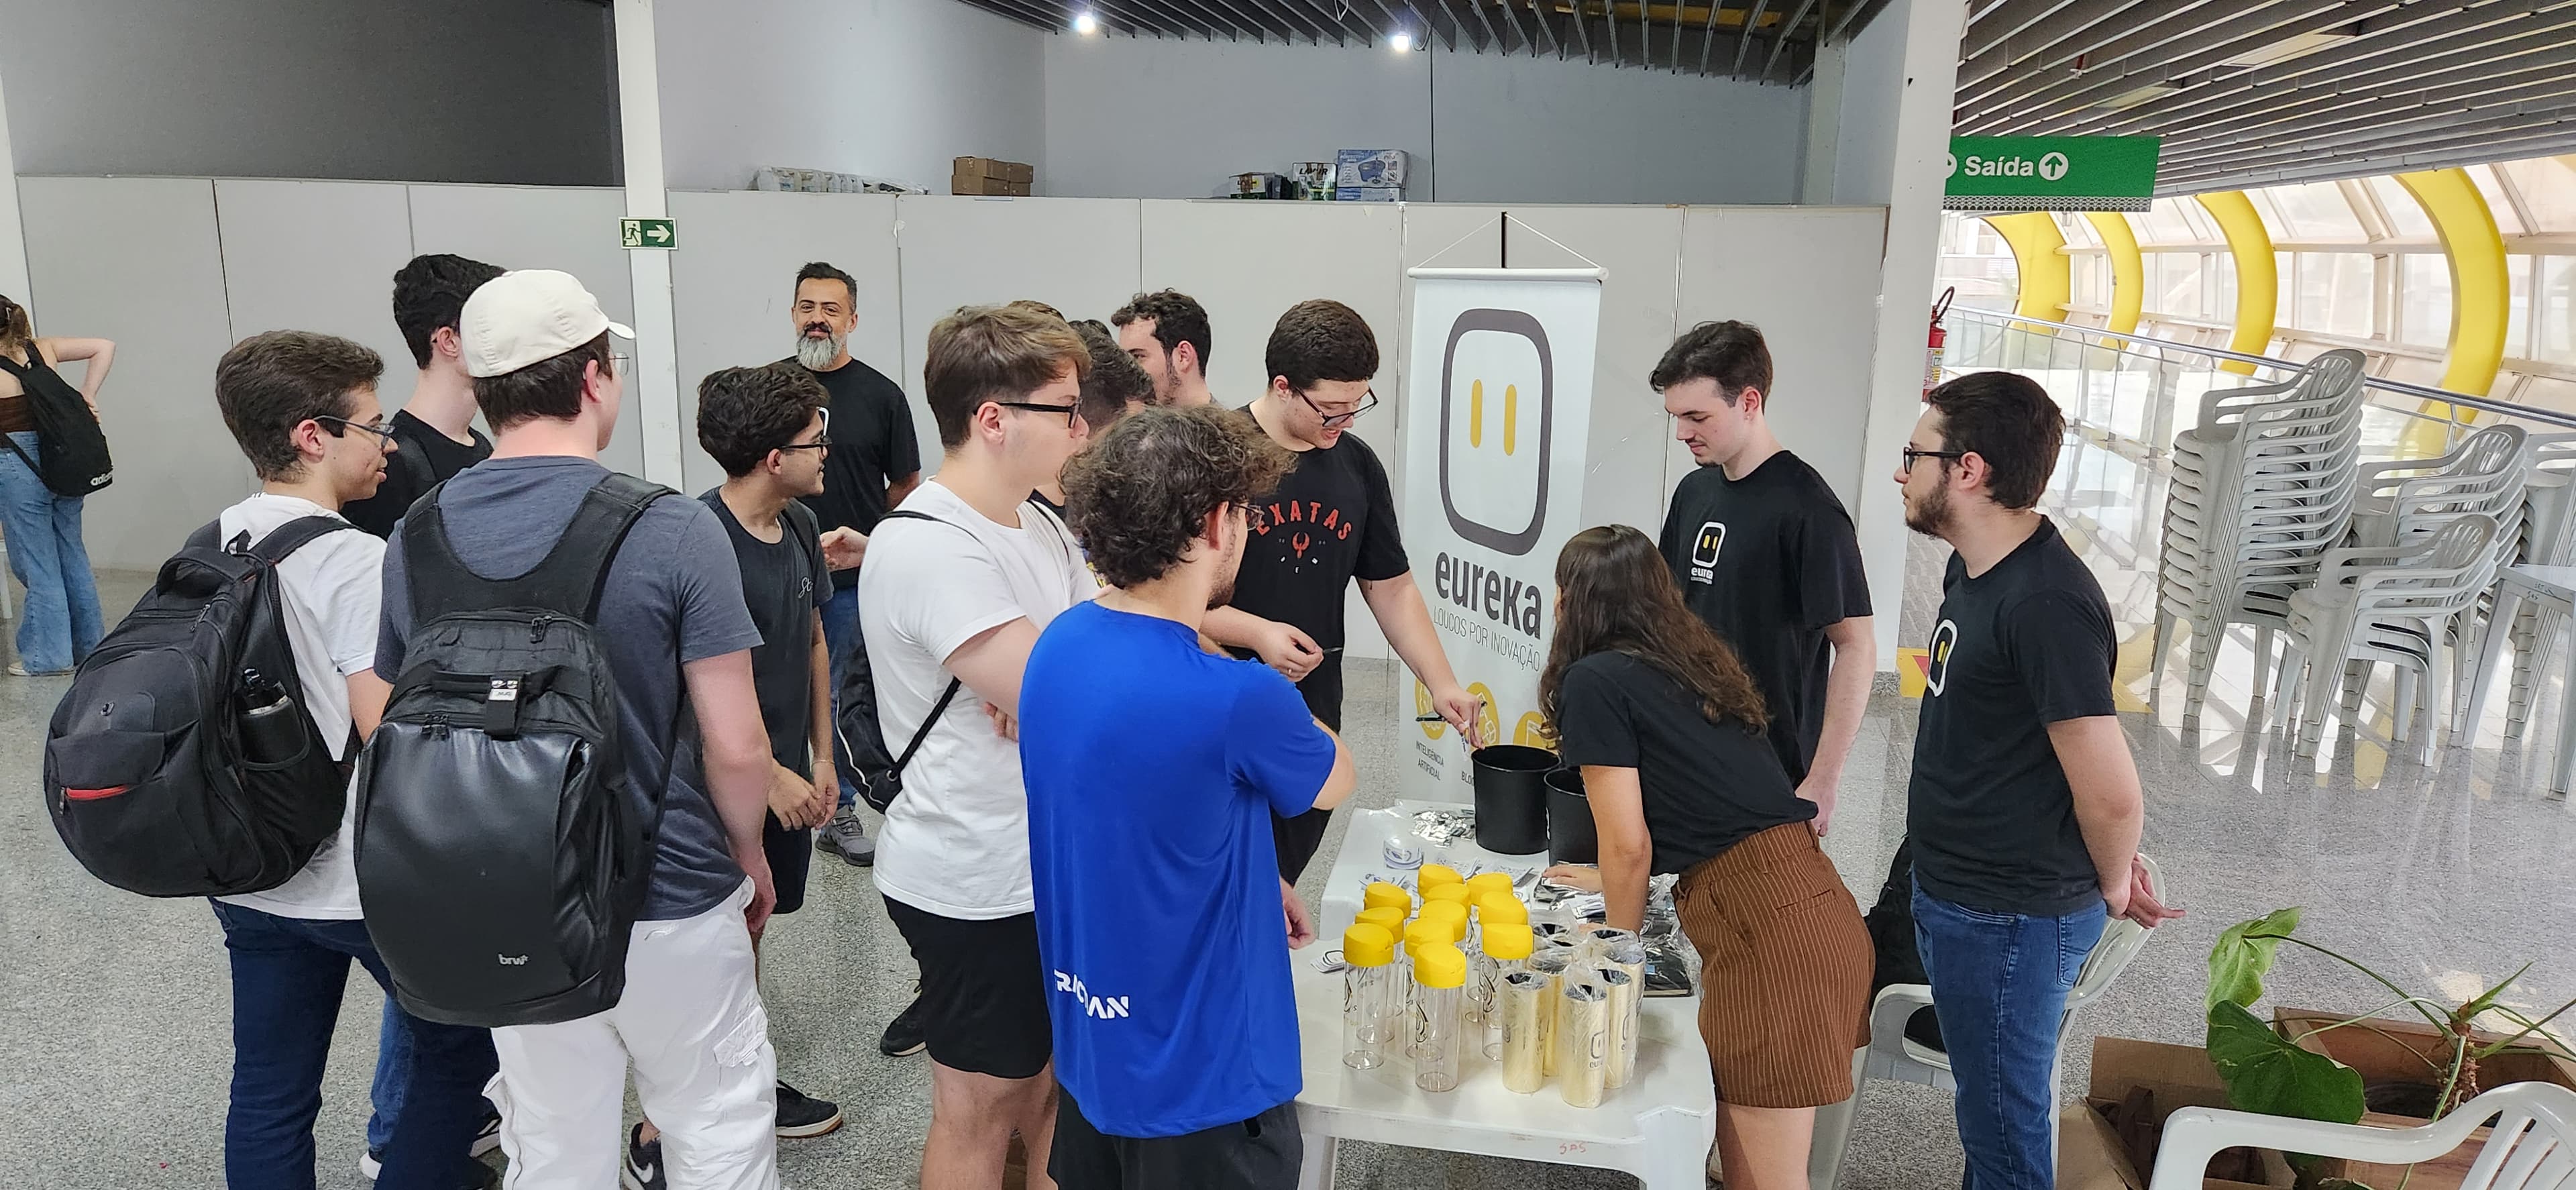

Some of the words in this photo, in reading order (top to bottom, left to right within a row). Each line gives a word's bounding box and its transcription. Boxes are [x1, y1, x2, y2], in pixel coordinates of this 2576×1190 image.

[1964, 156, 2034, 176] Saída
[1435, 551, 1542, 640] eureka
[1434, 606, 1467, 637] LOUCOS
[1469, 621, 1489, 648] POR
[1491, 631, 1541, 671] INOVAÇÃO
[1416, 740, 1444, 767] INTELIGÊNCIA
[1417, 757, 1441, 781] ARTIFICIAL
